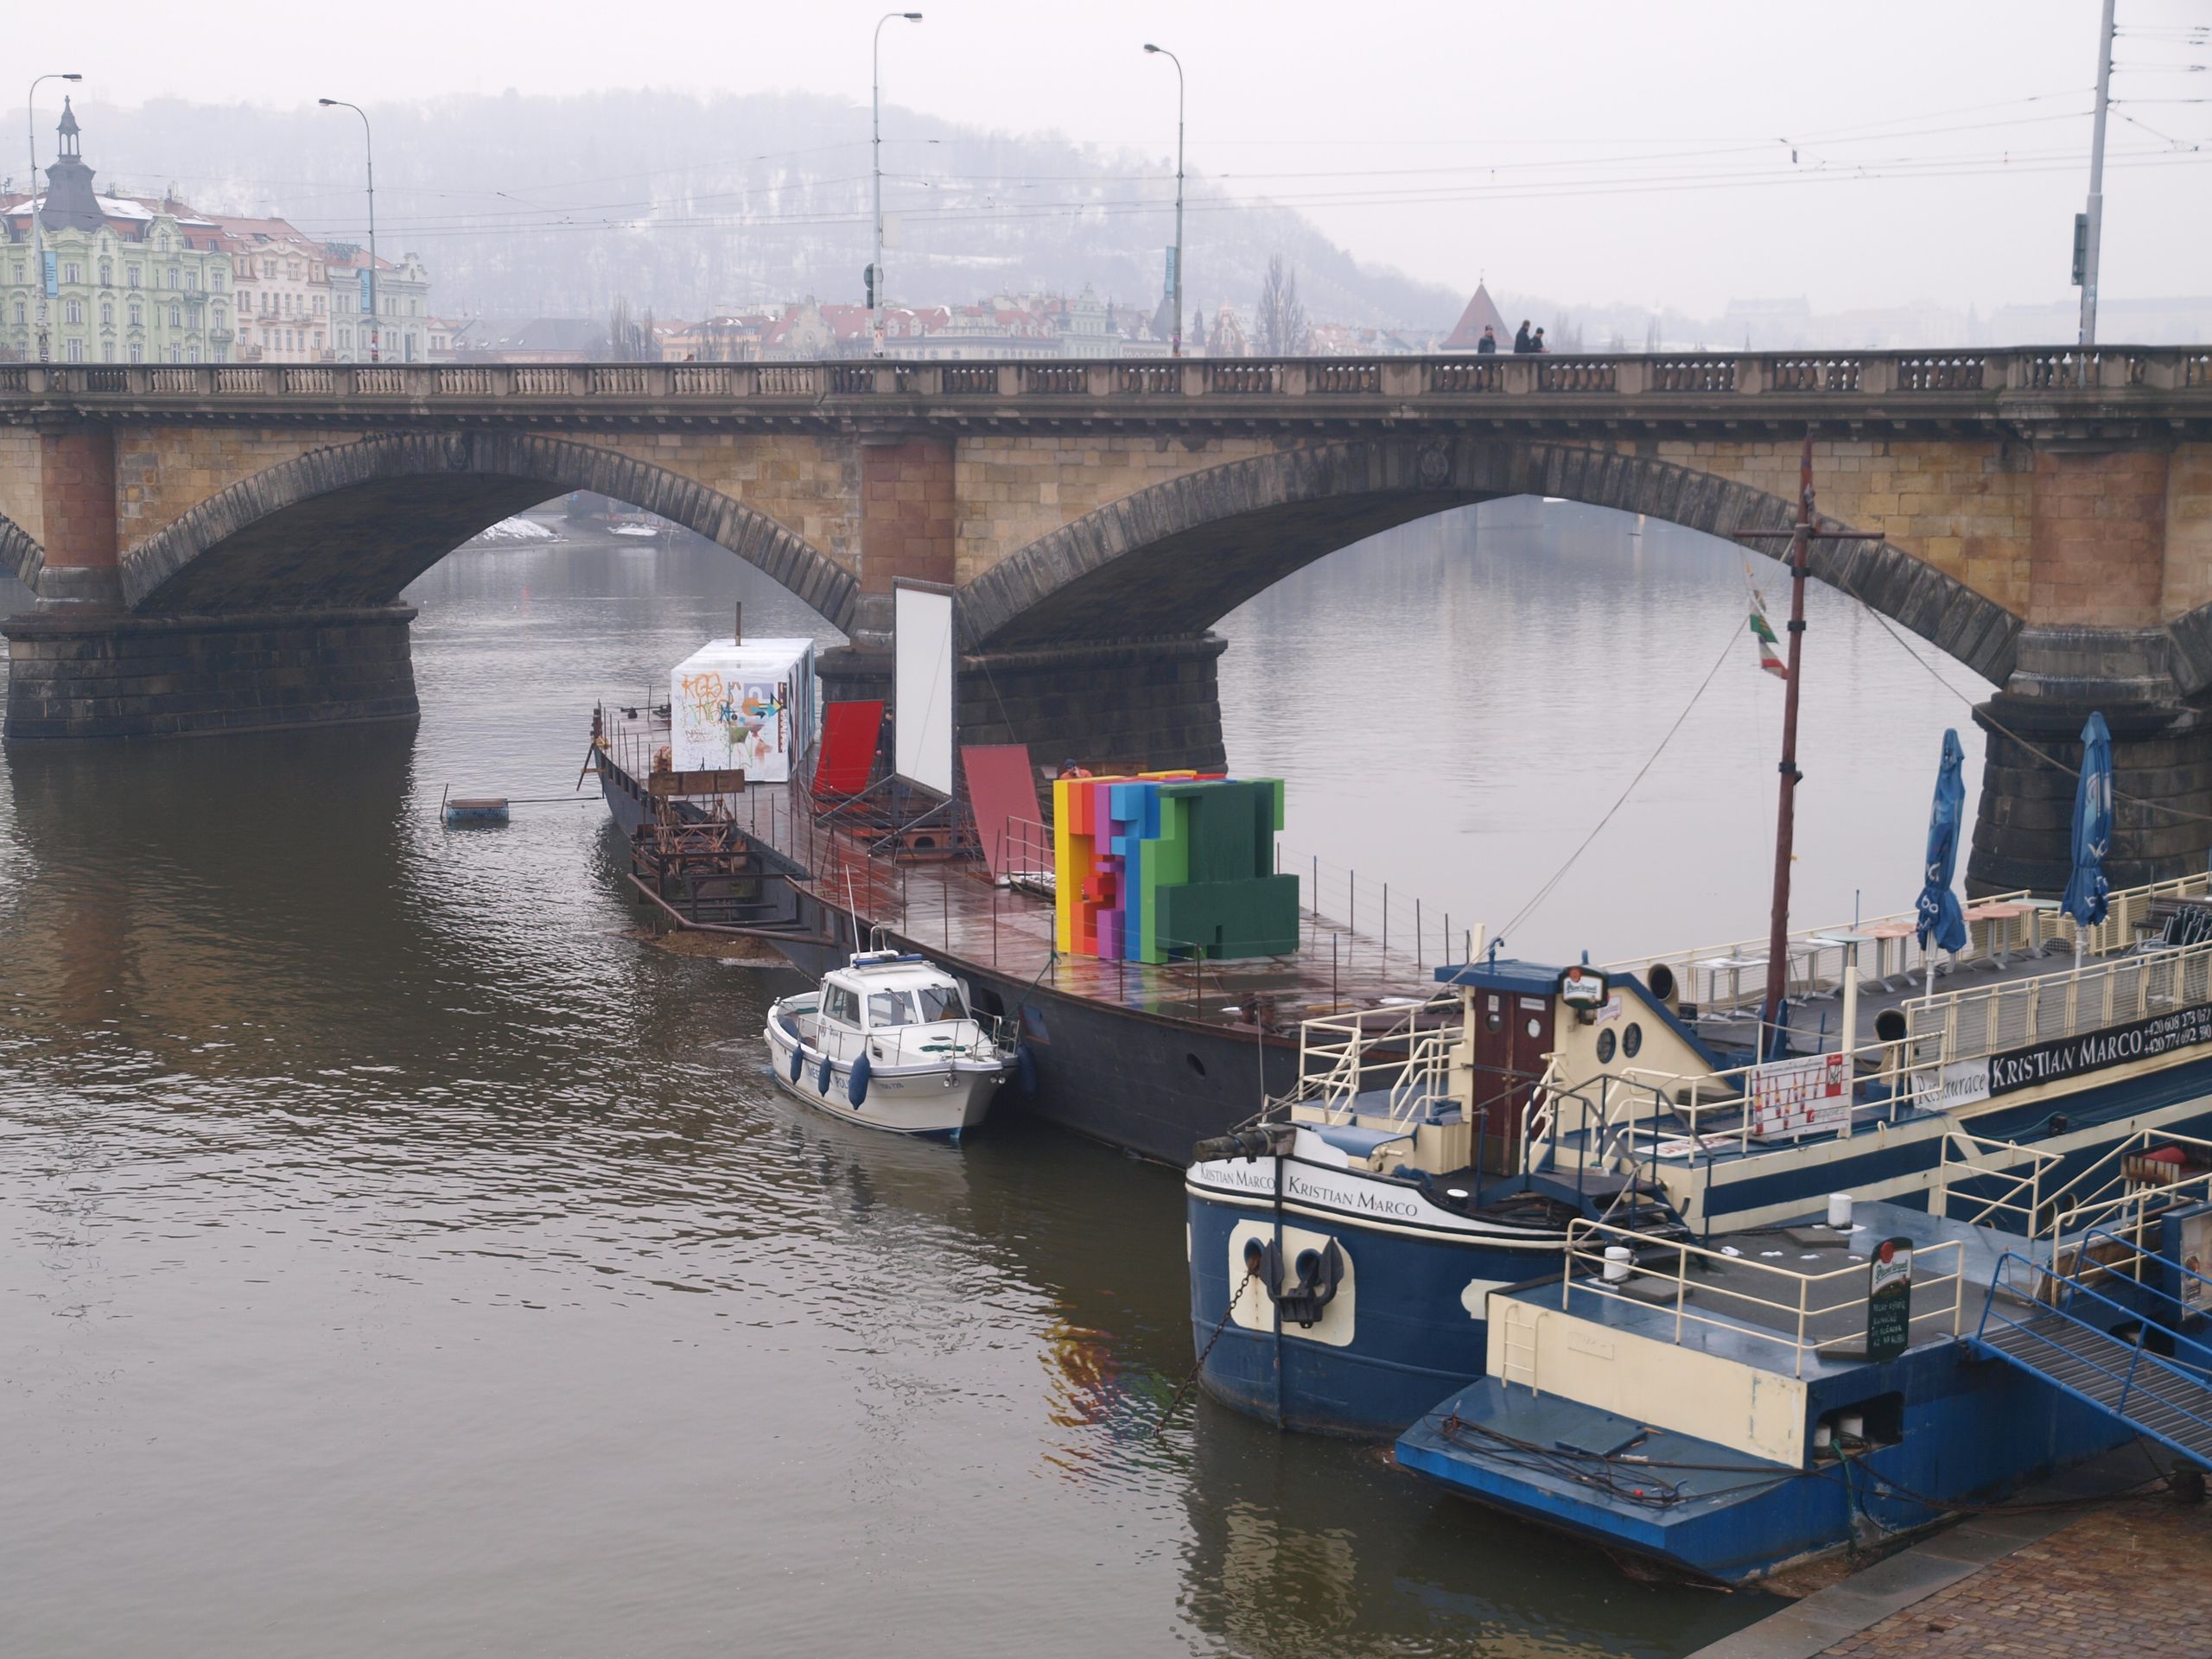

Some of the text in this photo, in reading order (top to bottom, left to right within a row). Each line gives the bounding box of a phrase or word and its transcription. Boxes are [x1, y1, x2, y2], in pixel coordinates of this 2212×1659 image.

[1992, 1031, 2142, 1089] KRISTIAN MARCO
[1916, 1073, 1986, 1104] Resaurace
[1236, 1170, 1275, 1190] MARCO
[1288, 1176, 1418, 1217] KRISTIAN MARCO
